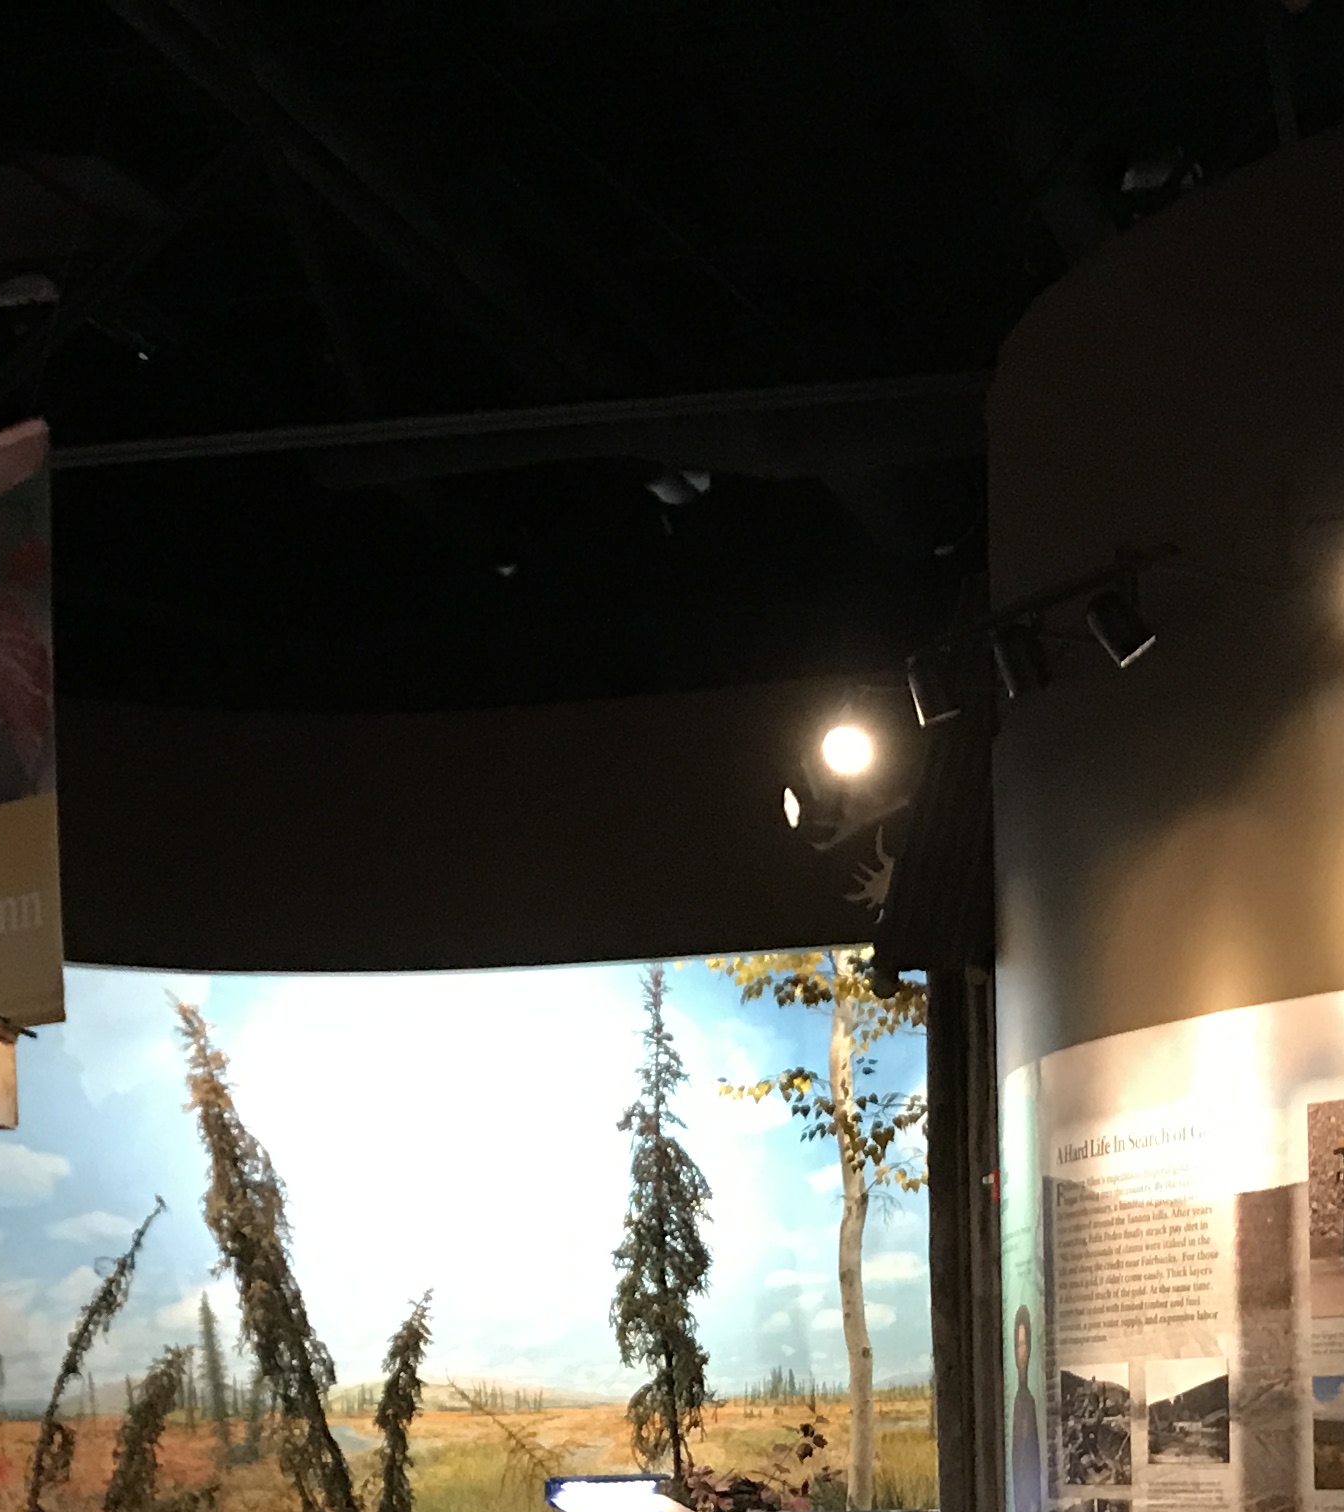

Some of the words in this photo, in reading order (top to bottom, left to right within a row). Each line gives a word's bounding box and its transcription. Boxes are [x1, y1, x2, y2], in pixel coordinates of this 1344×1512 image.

[1057, 1147, 1064, 1165] A
[1064, 1140, 1088, 1163] Hard
[1090, 1136, 1111, 1157] Life
[1114, 1135, 1125, 1153] In
[1128, 1127, 1169, 1150] Search
[1172, 1208, 1190, 1219] After
[1192, 1206, 1213, 1217] years
[1183, 1222, 1198, 1232] dirt
[1200, 1221, 1208, 1230] in
[1197, 1236, 1211, 1246] the
[1182, 1251, 1195, 1262] For
[1197, 1250, 1219, 1261] those
[1166, 1268, 1187, 1279] Thick
[1189, 1267, 1213, 1279] layers
[1197, 1310, 1218, 1321] labor
